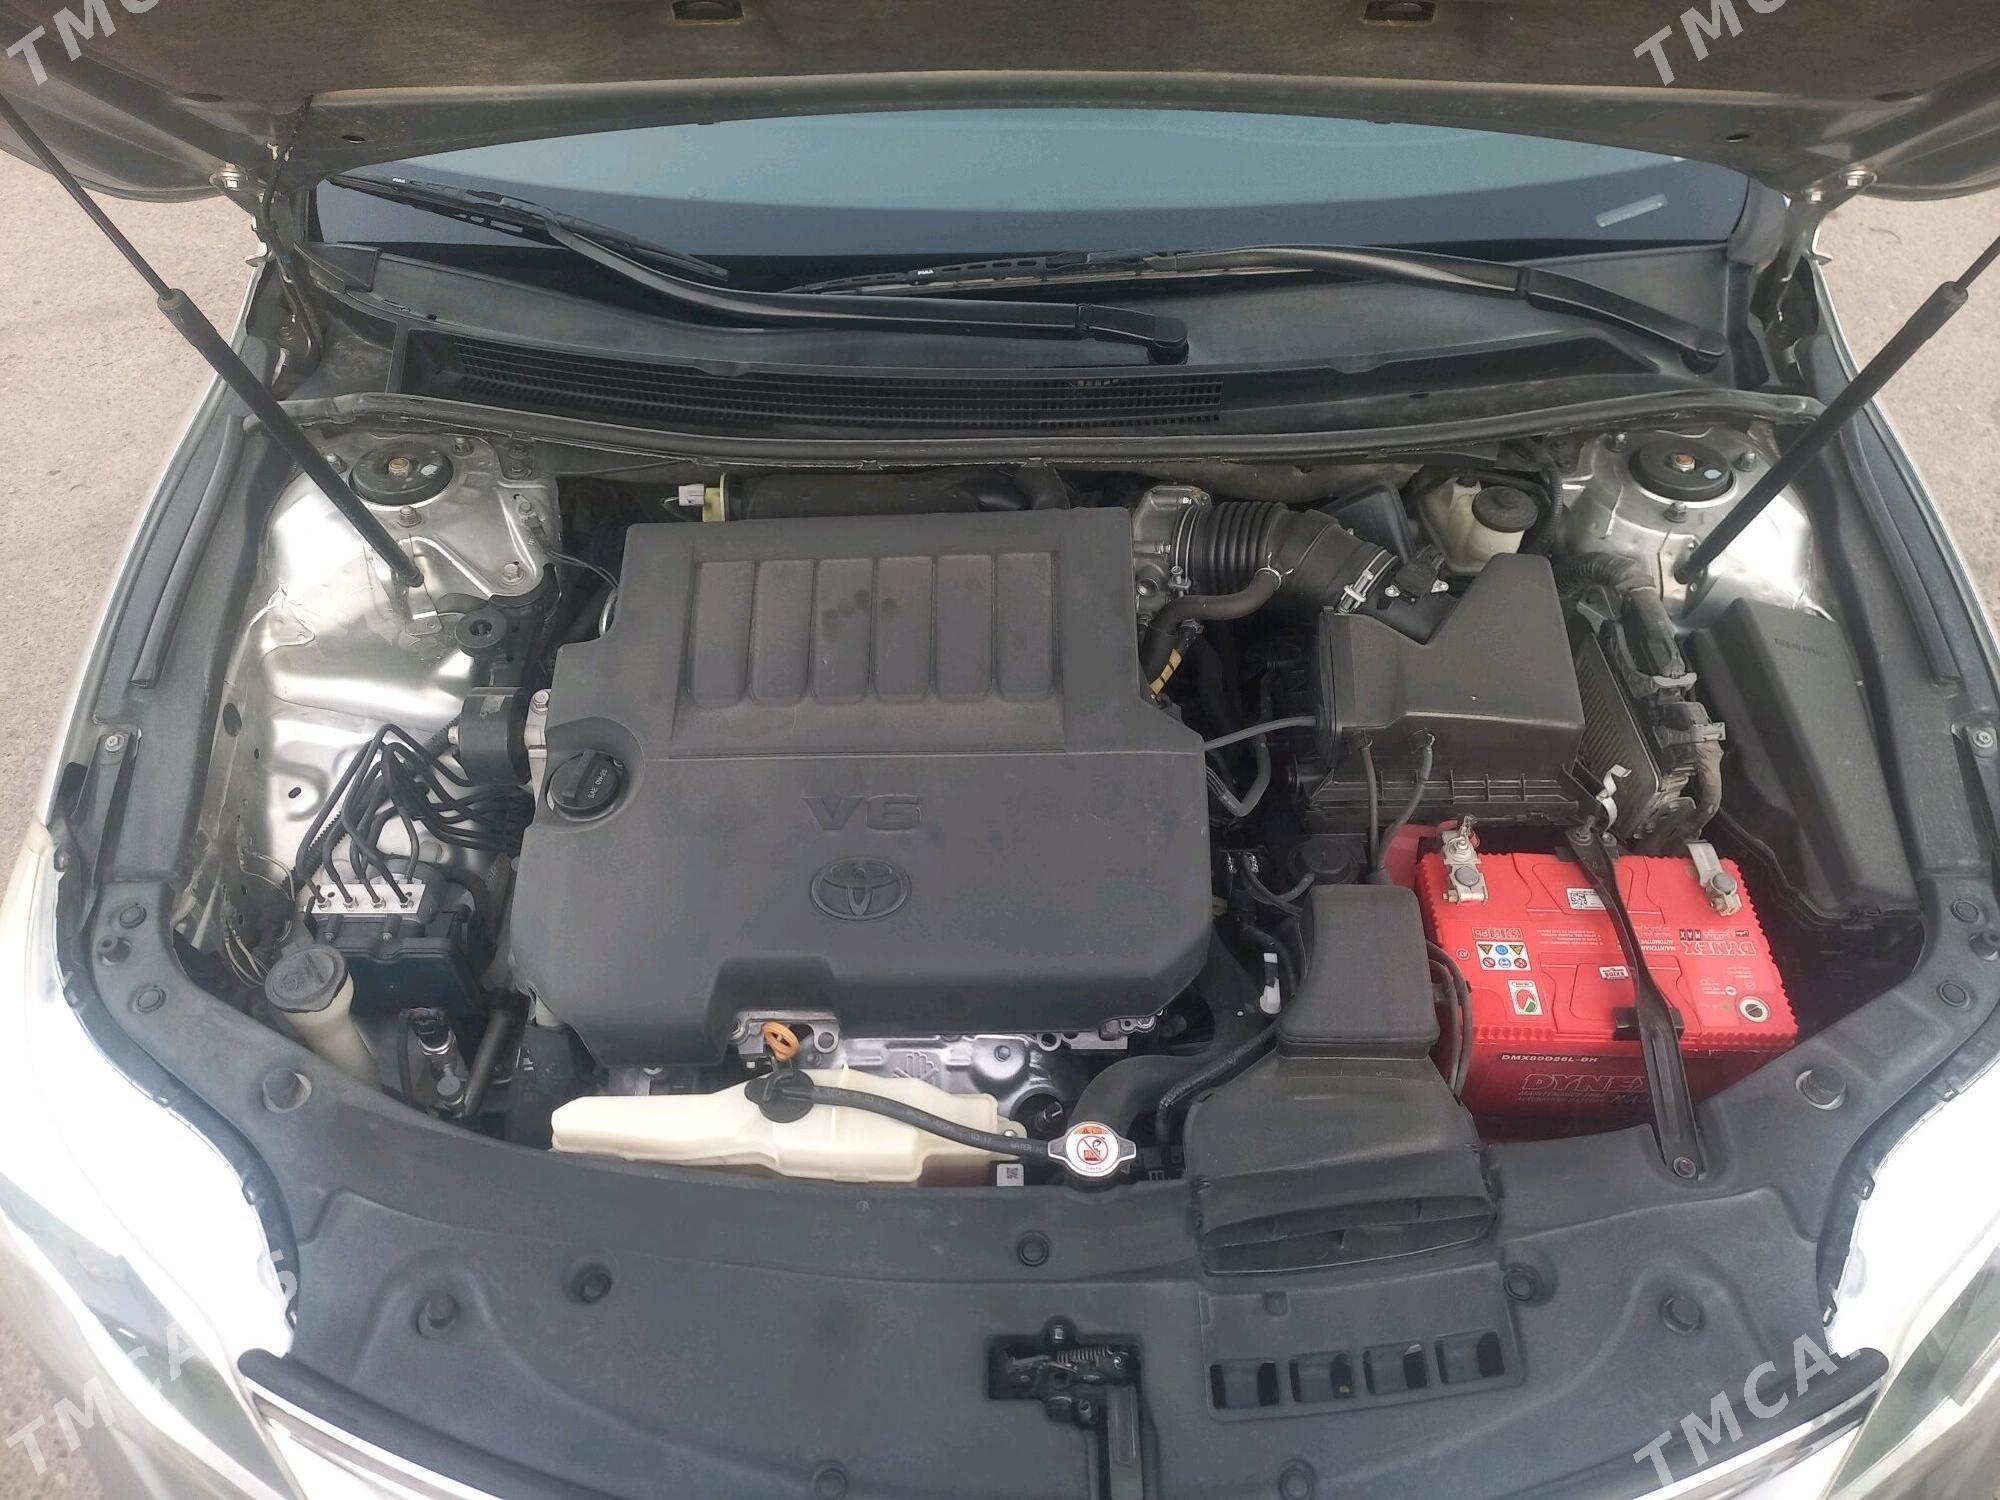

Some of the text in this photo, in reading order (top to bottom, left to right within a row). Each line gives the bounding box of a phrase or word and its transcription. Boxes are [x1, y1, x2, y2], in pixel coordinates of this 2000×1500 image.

[800, 794, 921, 831] V6
[1679, 929, 1701, 941] MAX
[1680, 940, 1758, 957] DYNEX
